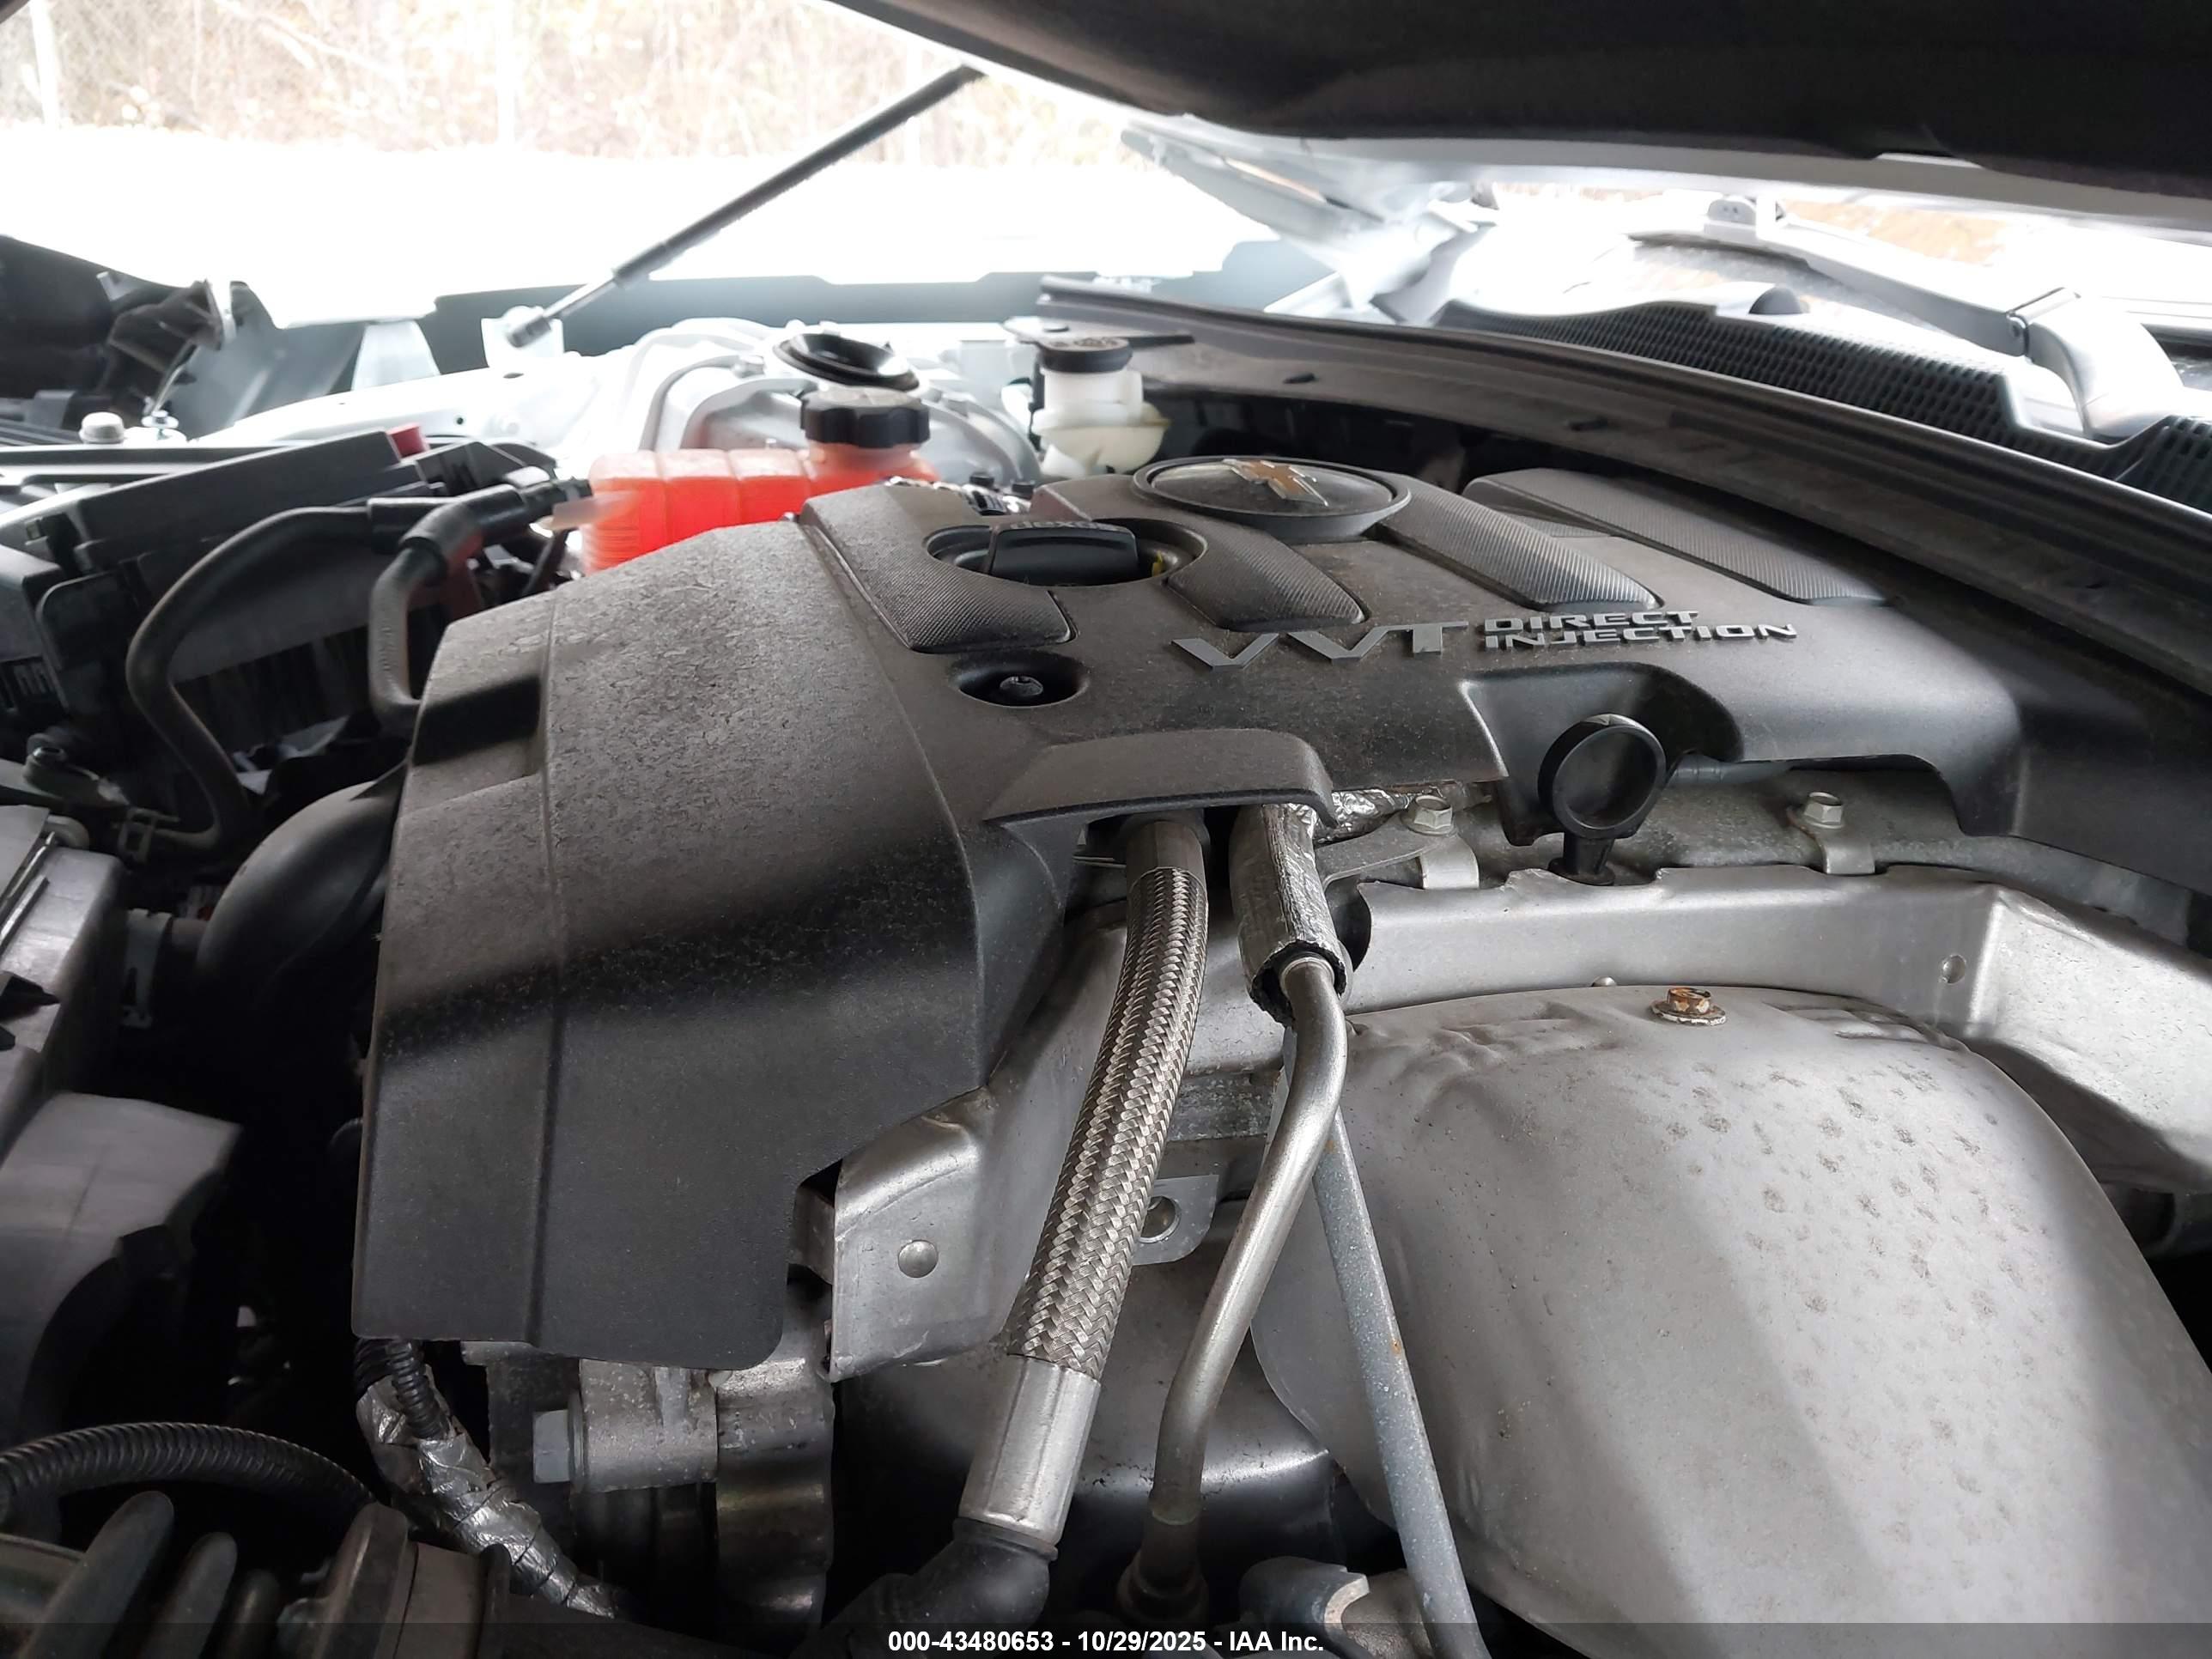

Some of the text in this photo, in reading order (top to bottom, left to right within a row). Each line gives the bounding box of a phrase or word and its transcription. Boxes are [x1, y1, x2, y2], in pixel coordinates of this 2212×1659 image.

[1484, 611, 1698, 633] DIRECT
[1171, 621, 1469, 670] VVT
[1484, 623, 1797, 649] INJECTION
